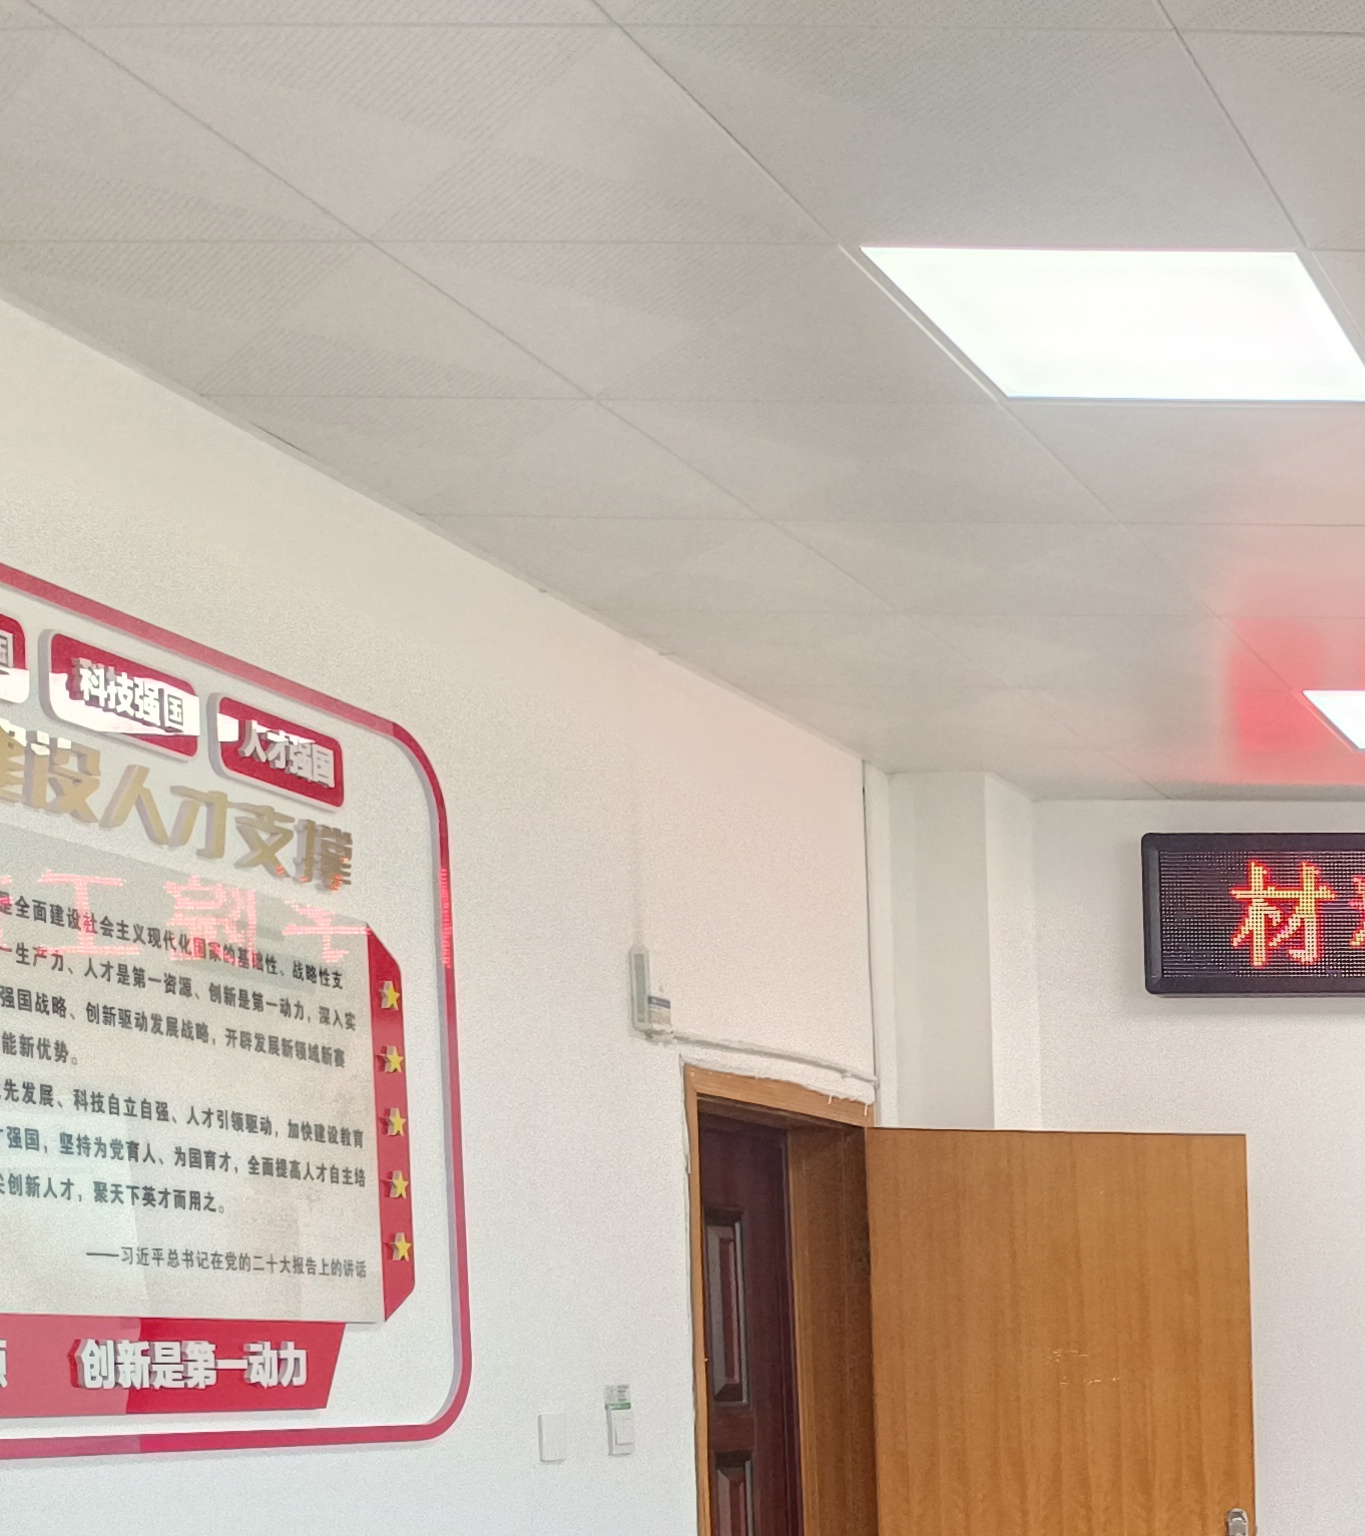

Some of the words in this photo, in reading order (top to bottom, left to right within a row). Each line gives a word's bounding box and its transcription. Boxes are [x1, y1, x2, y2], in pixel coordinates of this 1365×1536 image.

[80, 661, 184, 734] 科技强国
[244, 720, 335, 788] 人才强国
[0, 1078, 364, 1148] 先发展、科技自立自强、人才引领驱动，加快建设教育
[0, 1126, 366, 1187] 强国，坚持为党育人、为国育才，全面提高人才自主培
[80, 1338, 308, 1390] 创新是第一动力
